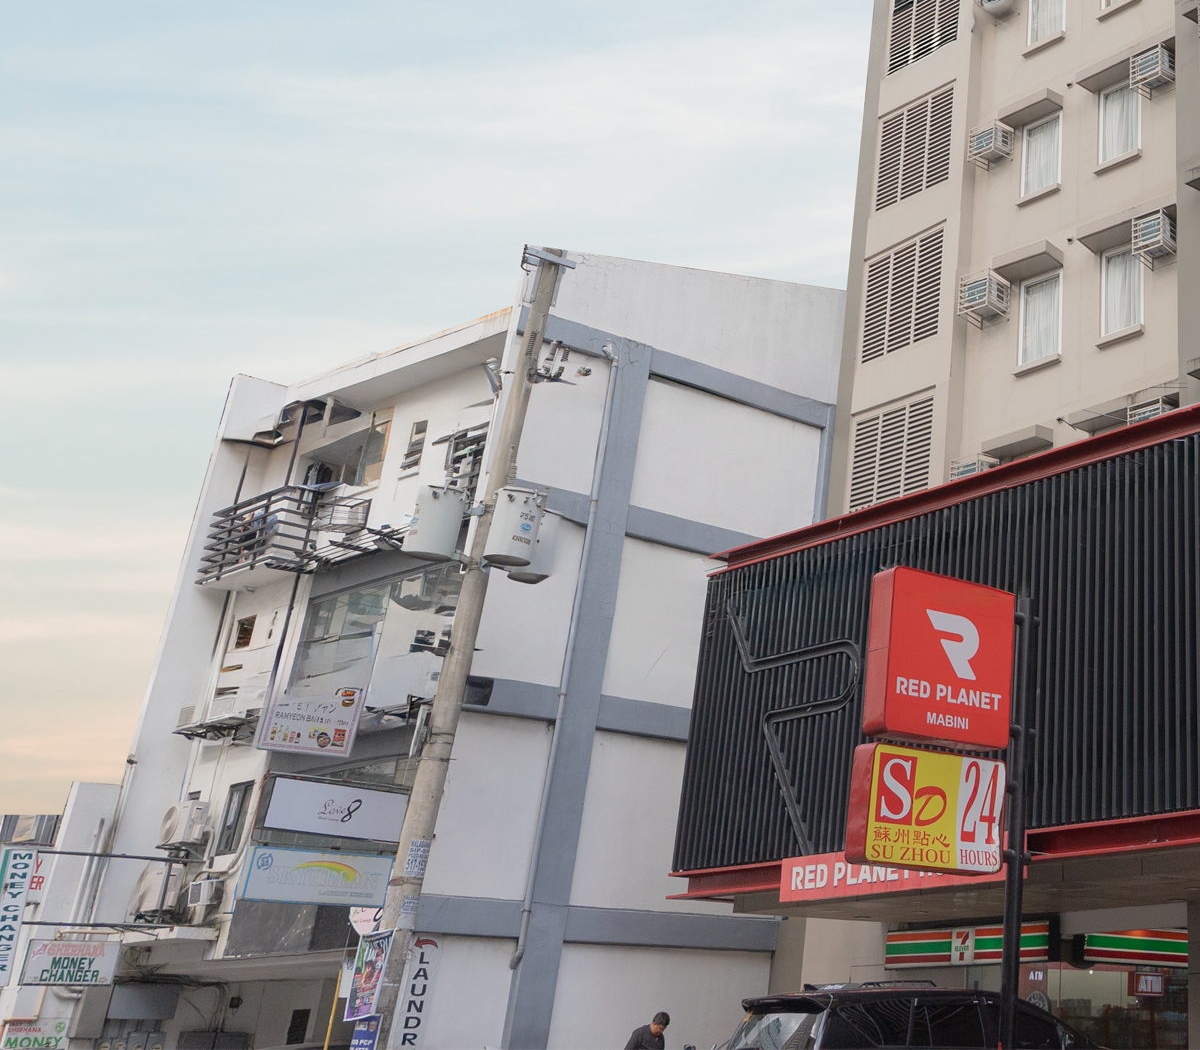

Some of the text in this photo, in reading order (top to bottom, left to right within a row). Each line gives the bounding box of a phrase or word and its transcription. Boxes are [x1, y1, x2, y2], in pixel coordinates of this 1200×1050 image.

[926, 608, 980, 680] R
[896, 676, 1001, 710] RED PLANET
[926, 711, 969, 729] MABINI
[341, 799, 362, 822] 8
[960, 760, 999, 845] 24
[872, 826, 950, 848] 蘇州點心
[870, 844, 950, 864] SU ZHOU
[959, 848, 998, 866] HOURS
[7, 853, 33, 899] MONEY
[266, 864, 380, 890] SKYCLEAN
[791, 863, 828, 891] RED
[956, 931, 970, 961] 7
[50, 956, 96, 970] MONEY
[39, 969, 100, 983] CHANGER
[1137, 975, 1162, 993] ATM
[401, 952, 430, 1047] LAUNDR
[4, 1036, 64, 1048] MONEY
